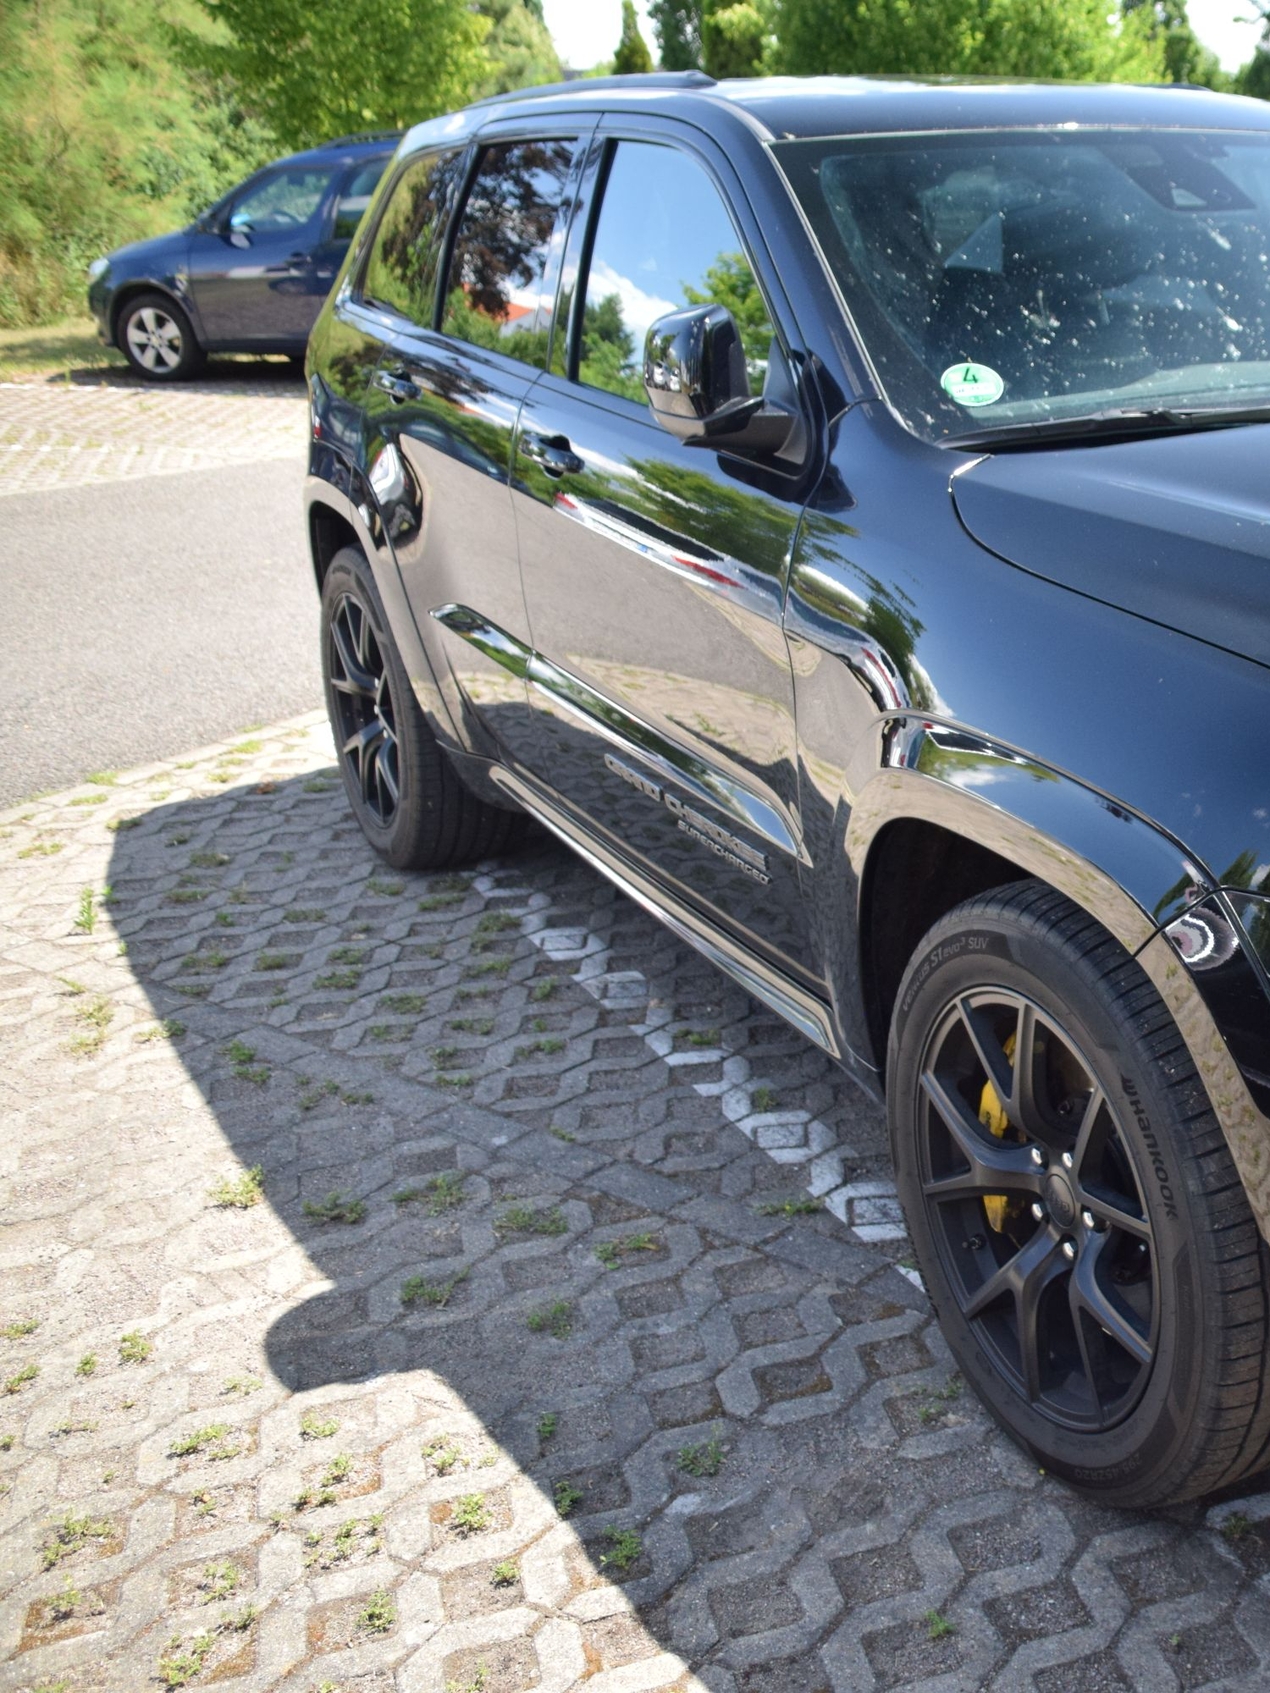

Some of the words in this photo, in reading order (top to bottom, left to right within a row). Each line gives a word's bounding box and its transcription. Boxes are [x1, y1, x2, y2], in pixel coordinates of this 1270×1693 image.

[962, 366, 979, 384] 4
[664, 793, 770, 873] CHEROKEE
[677, 819, 772, 885] SUPERCHARGED
[967, 936, 990, 950] SUV
